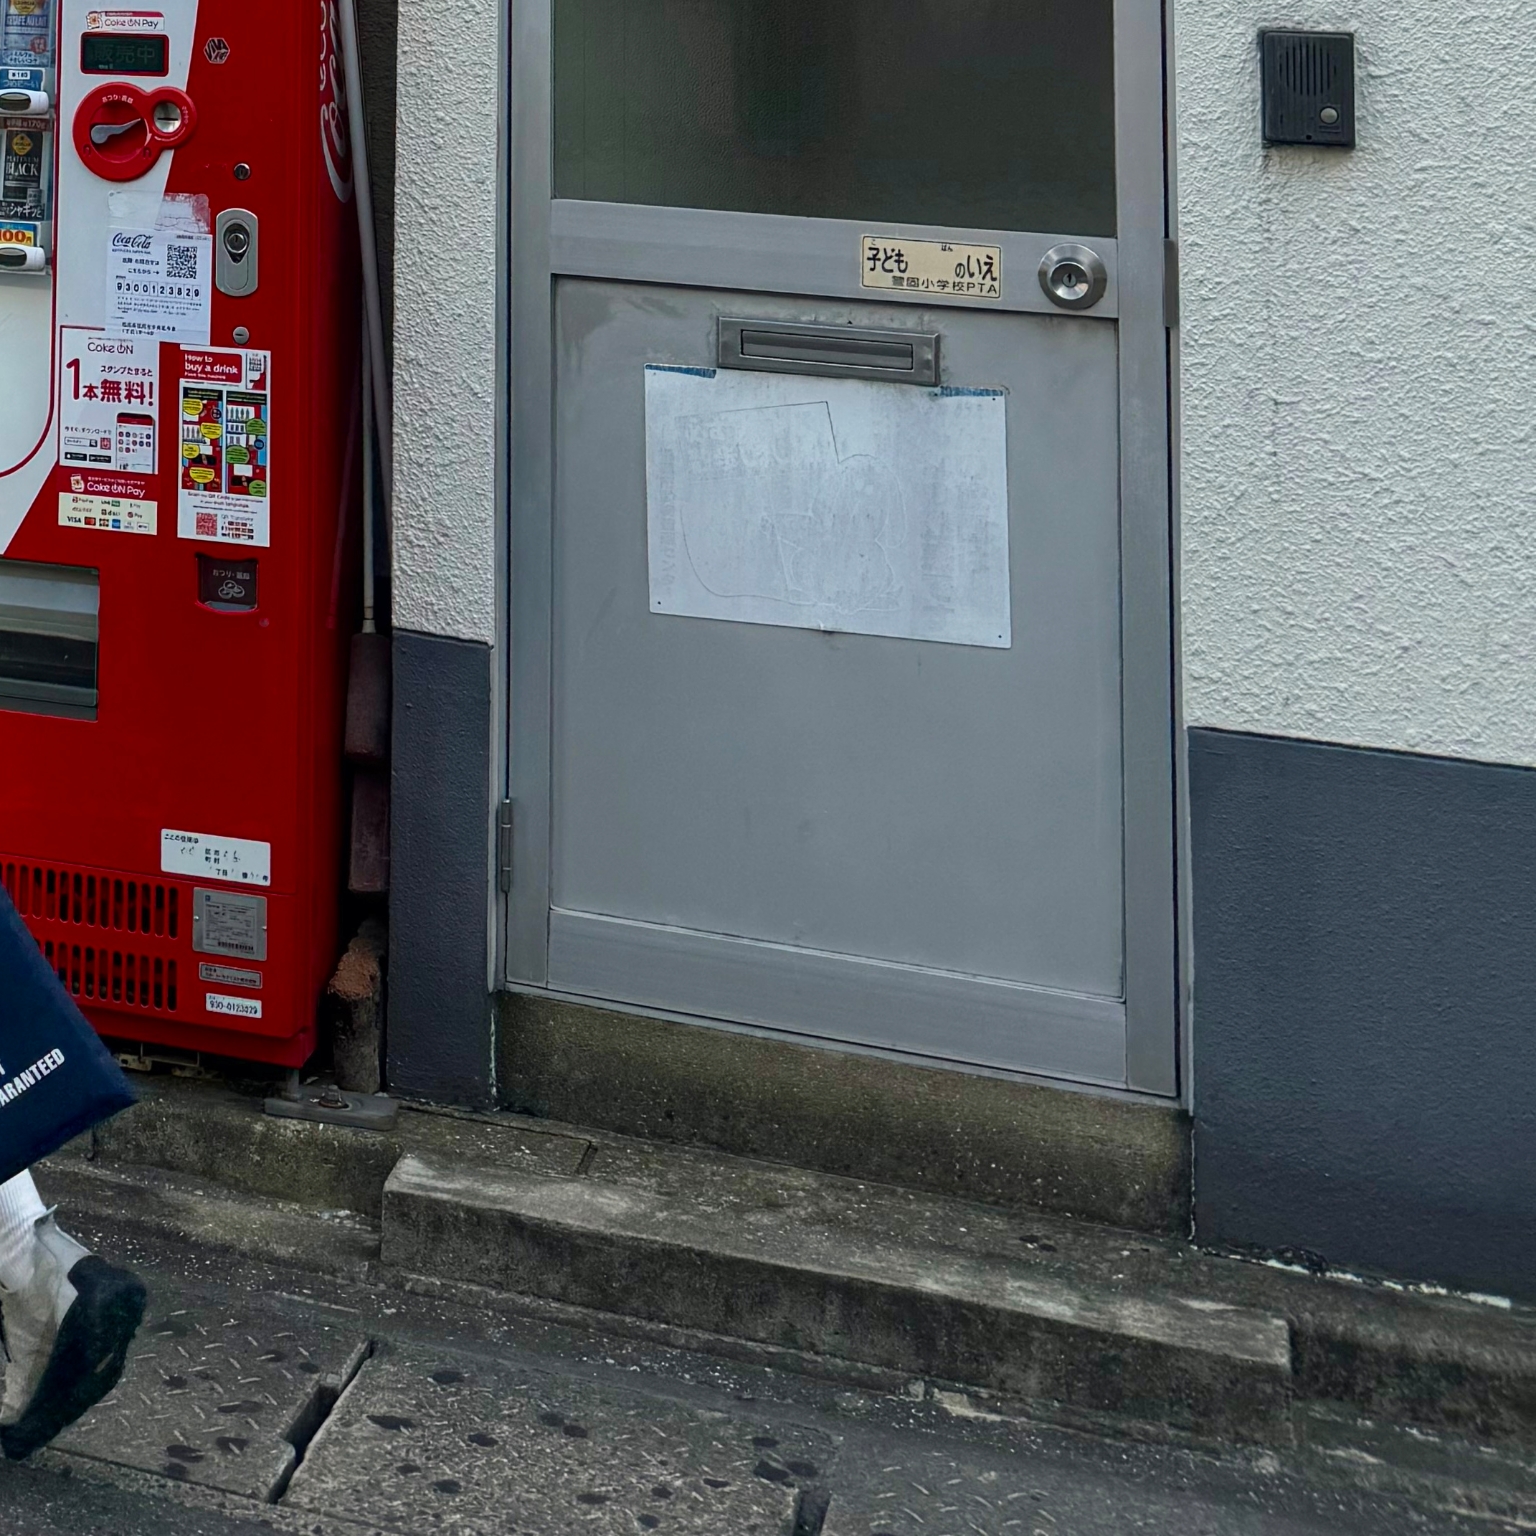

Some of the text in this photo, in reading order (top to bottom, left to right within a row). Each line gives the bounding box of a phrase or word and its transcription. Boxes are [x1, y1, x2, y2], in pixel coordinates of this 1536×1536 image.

[104, 17, 159, 29] Coke ON Pay
[6, 162, 38, 176] BLACK
[112, 232, 154, 249] Coca-Cola
[866, 247, 997, 282] 子ども のいえ
[87, 342, 134, 355] Coke ON
[185, 353, 213, 363] How to
[100, 365, 154, 377] スタンプたまると
[185, 362, 239, 375] buy a drink
[66, 357, 154, 407] 1本無料!
[87, 482, 145, 498] Coke ON Pay
[67, 515, 82, 524] VISA
